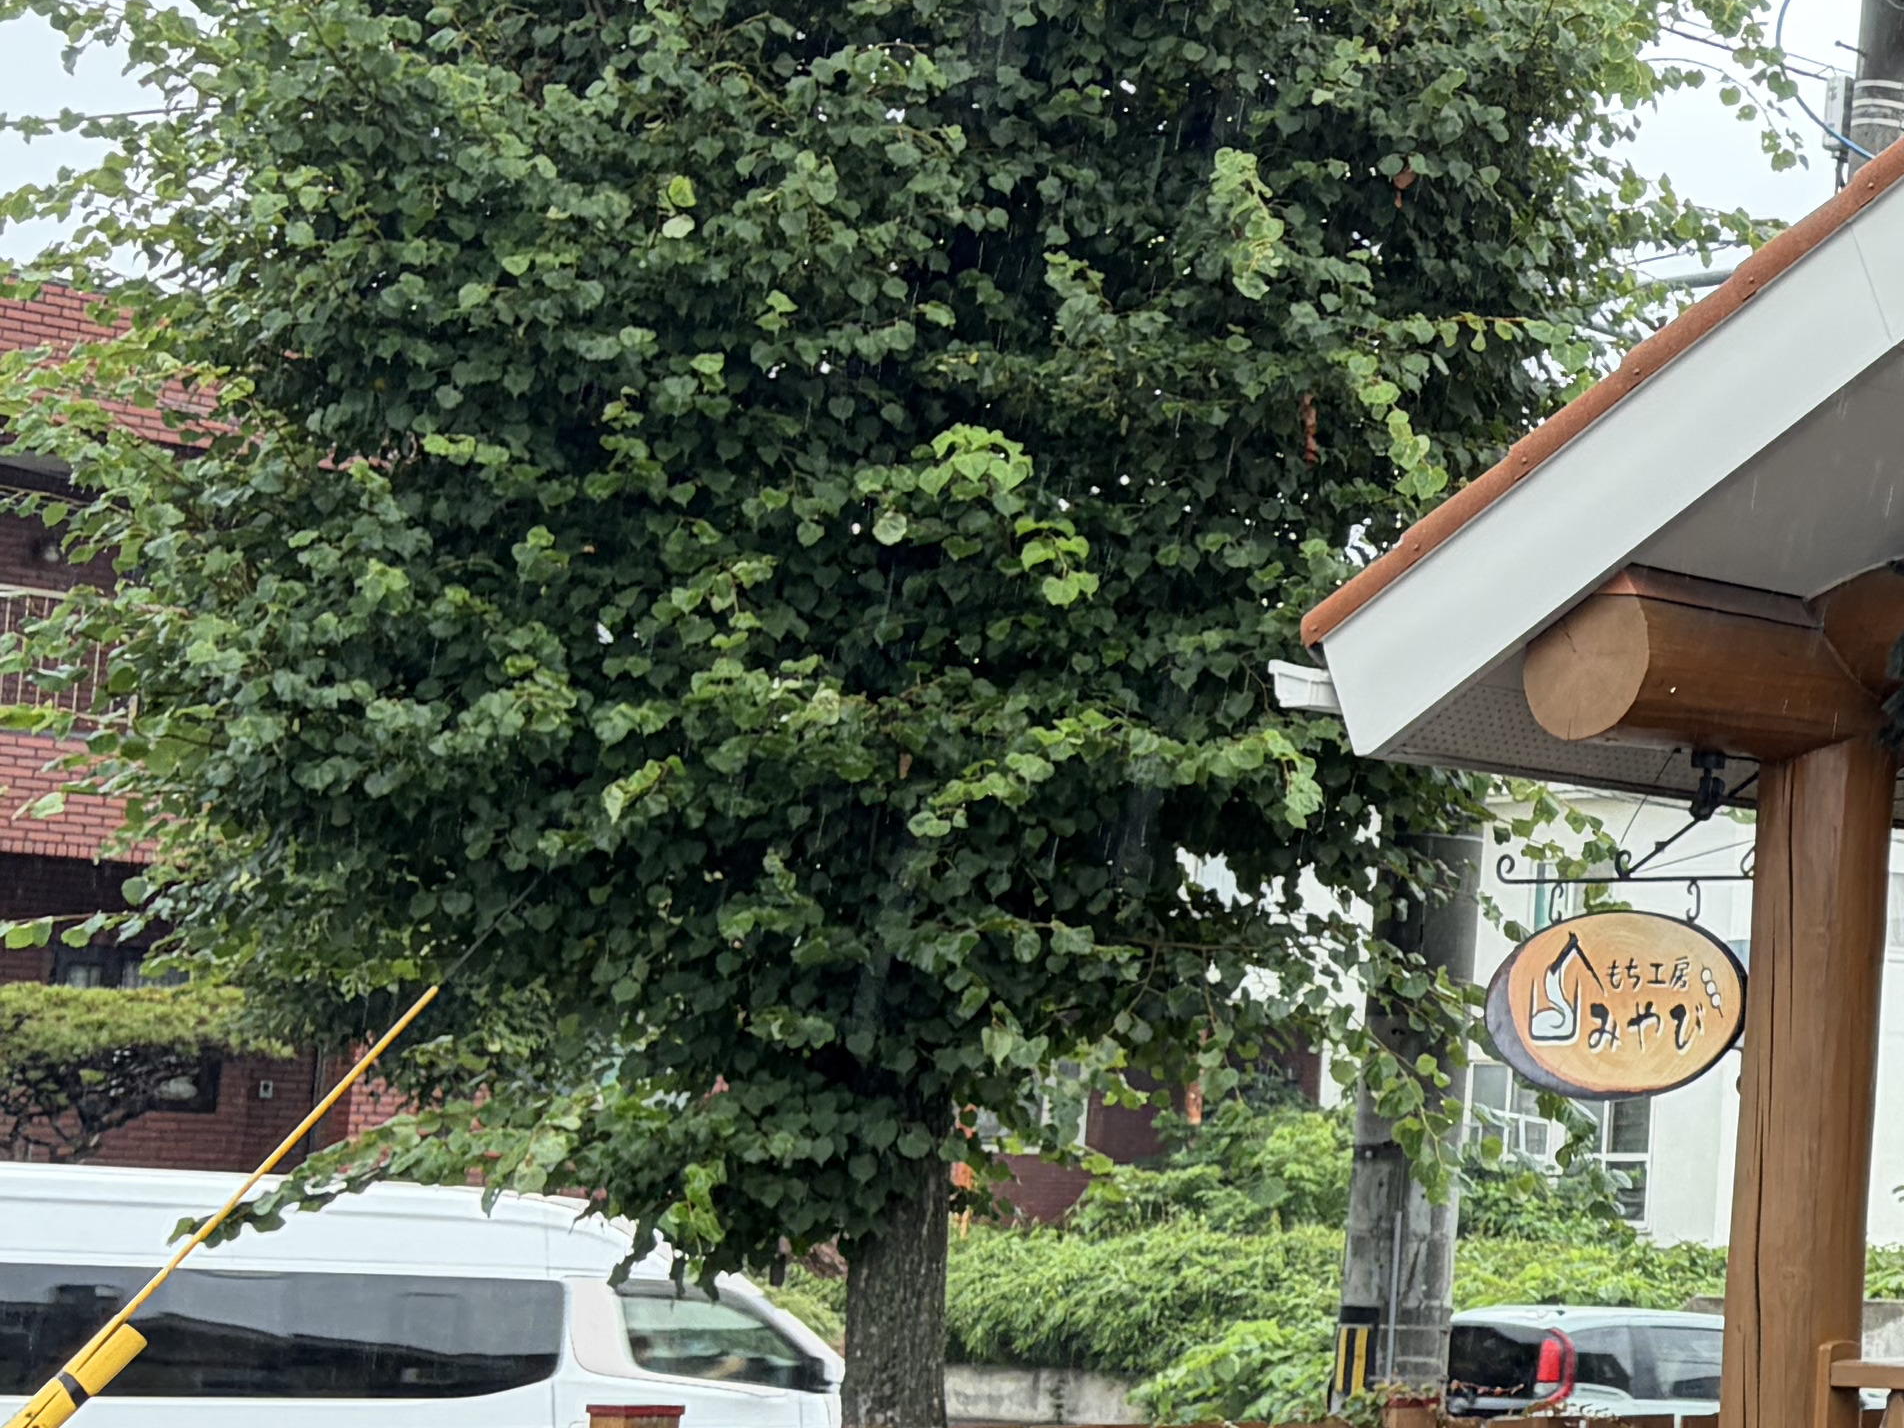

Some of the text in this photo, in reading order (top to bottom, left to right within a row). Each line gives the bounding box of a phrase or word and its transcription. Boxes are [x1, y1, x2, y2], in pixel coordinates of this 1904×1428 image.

[1606, 956, 1690, 991] もち工房
[1588, 1000, 1704, 1053] みやび
